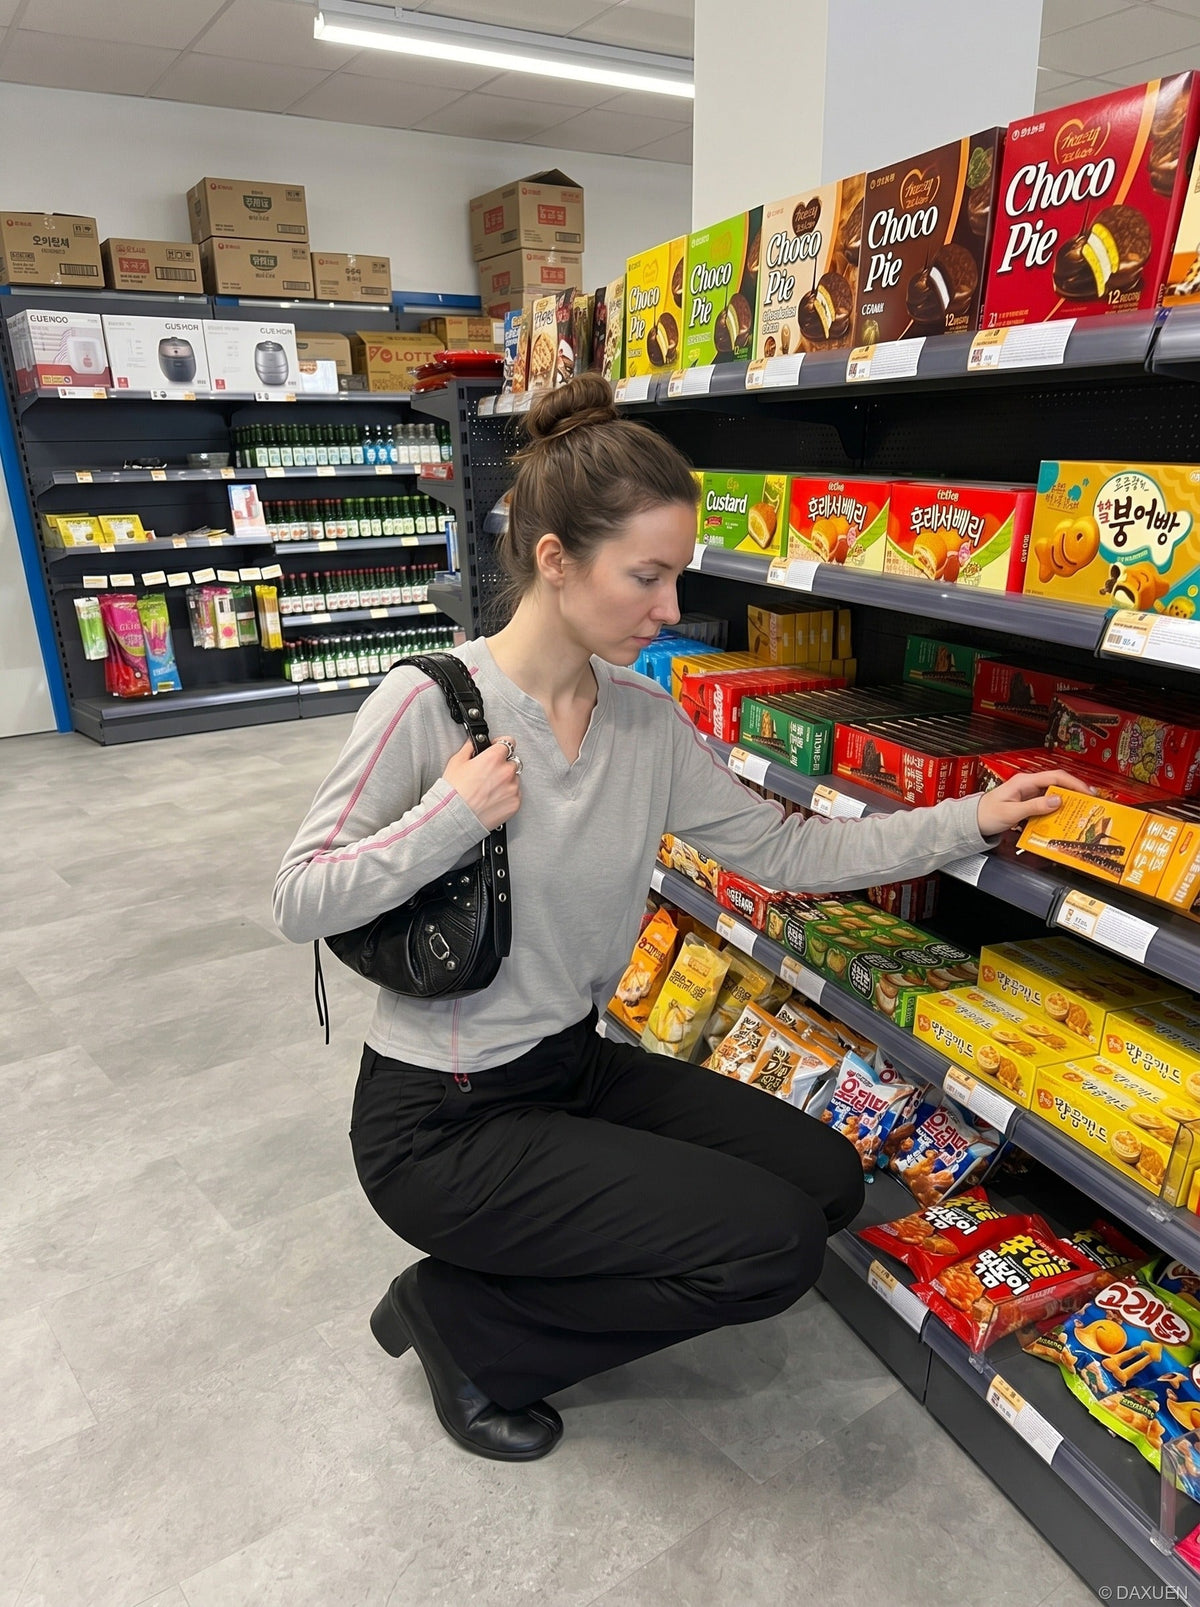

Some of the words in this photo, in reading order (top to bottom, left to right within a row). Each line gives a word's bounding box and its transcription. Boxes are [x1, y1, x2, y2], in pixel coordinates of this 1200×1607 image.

[1004, 157, 1116, 217] Choco
[867, 205, 939, 249] Choco
[767, 230, 822, 268] Choco
[996, 219, 1058, 273] Pie
[690, 262, 732, 295] Choco
[764, 269, 796, 305] Pie
[863, 251, 903, 293] Pie
[628, 286, 661, 313] Choco
[689, 297, 713, 328] Pie
[627, 316, 646, 342] Pie
[395, 351, 433, 362] LOTT
[706, 490, 748, 514] Custard
[1108, 495, 1181, 548] 붕어빵
